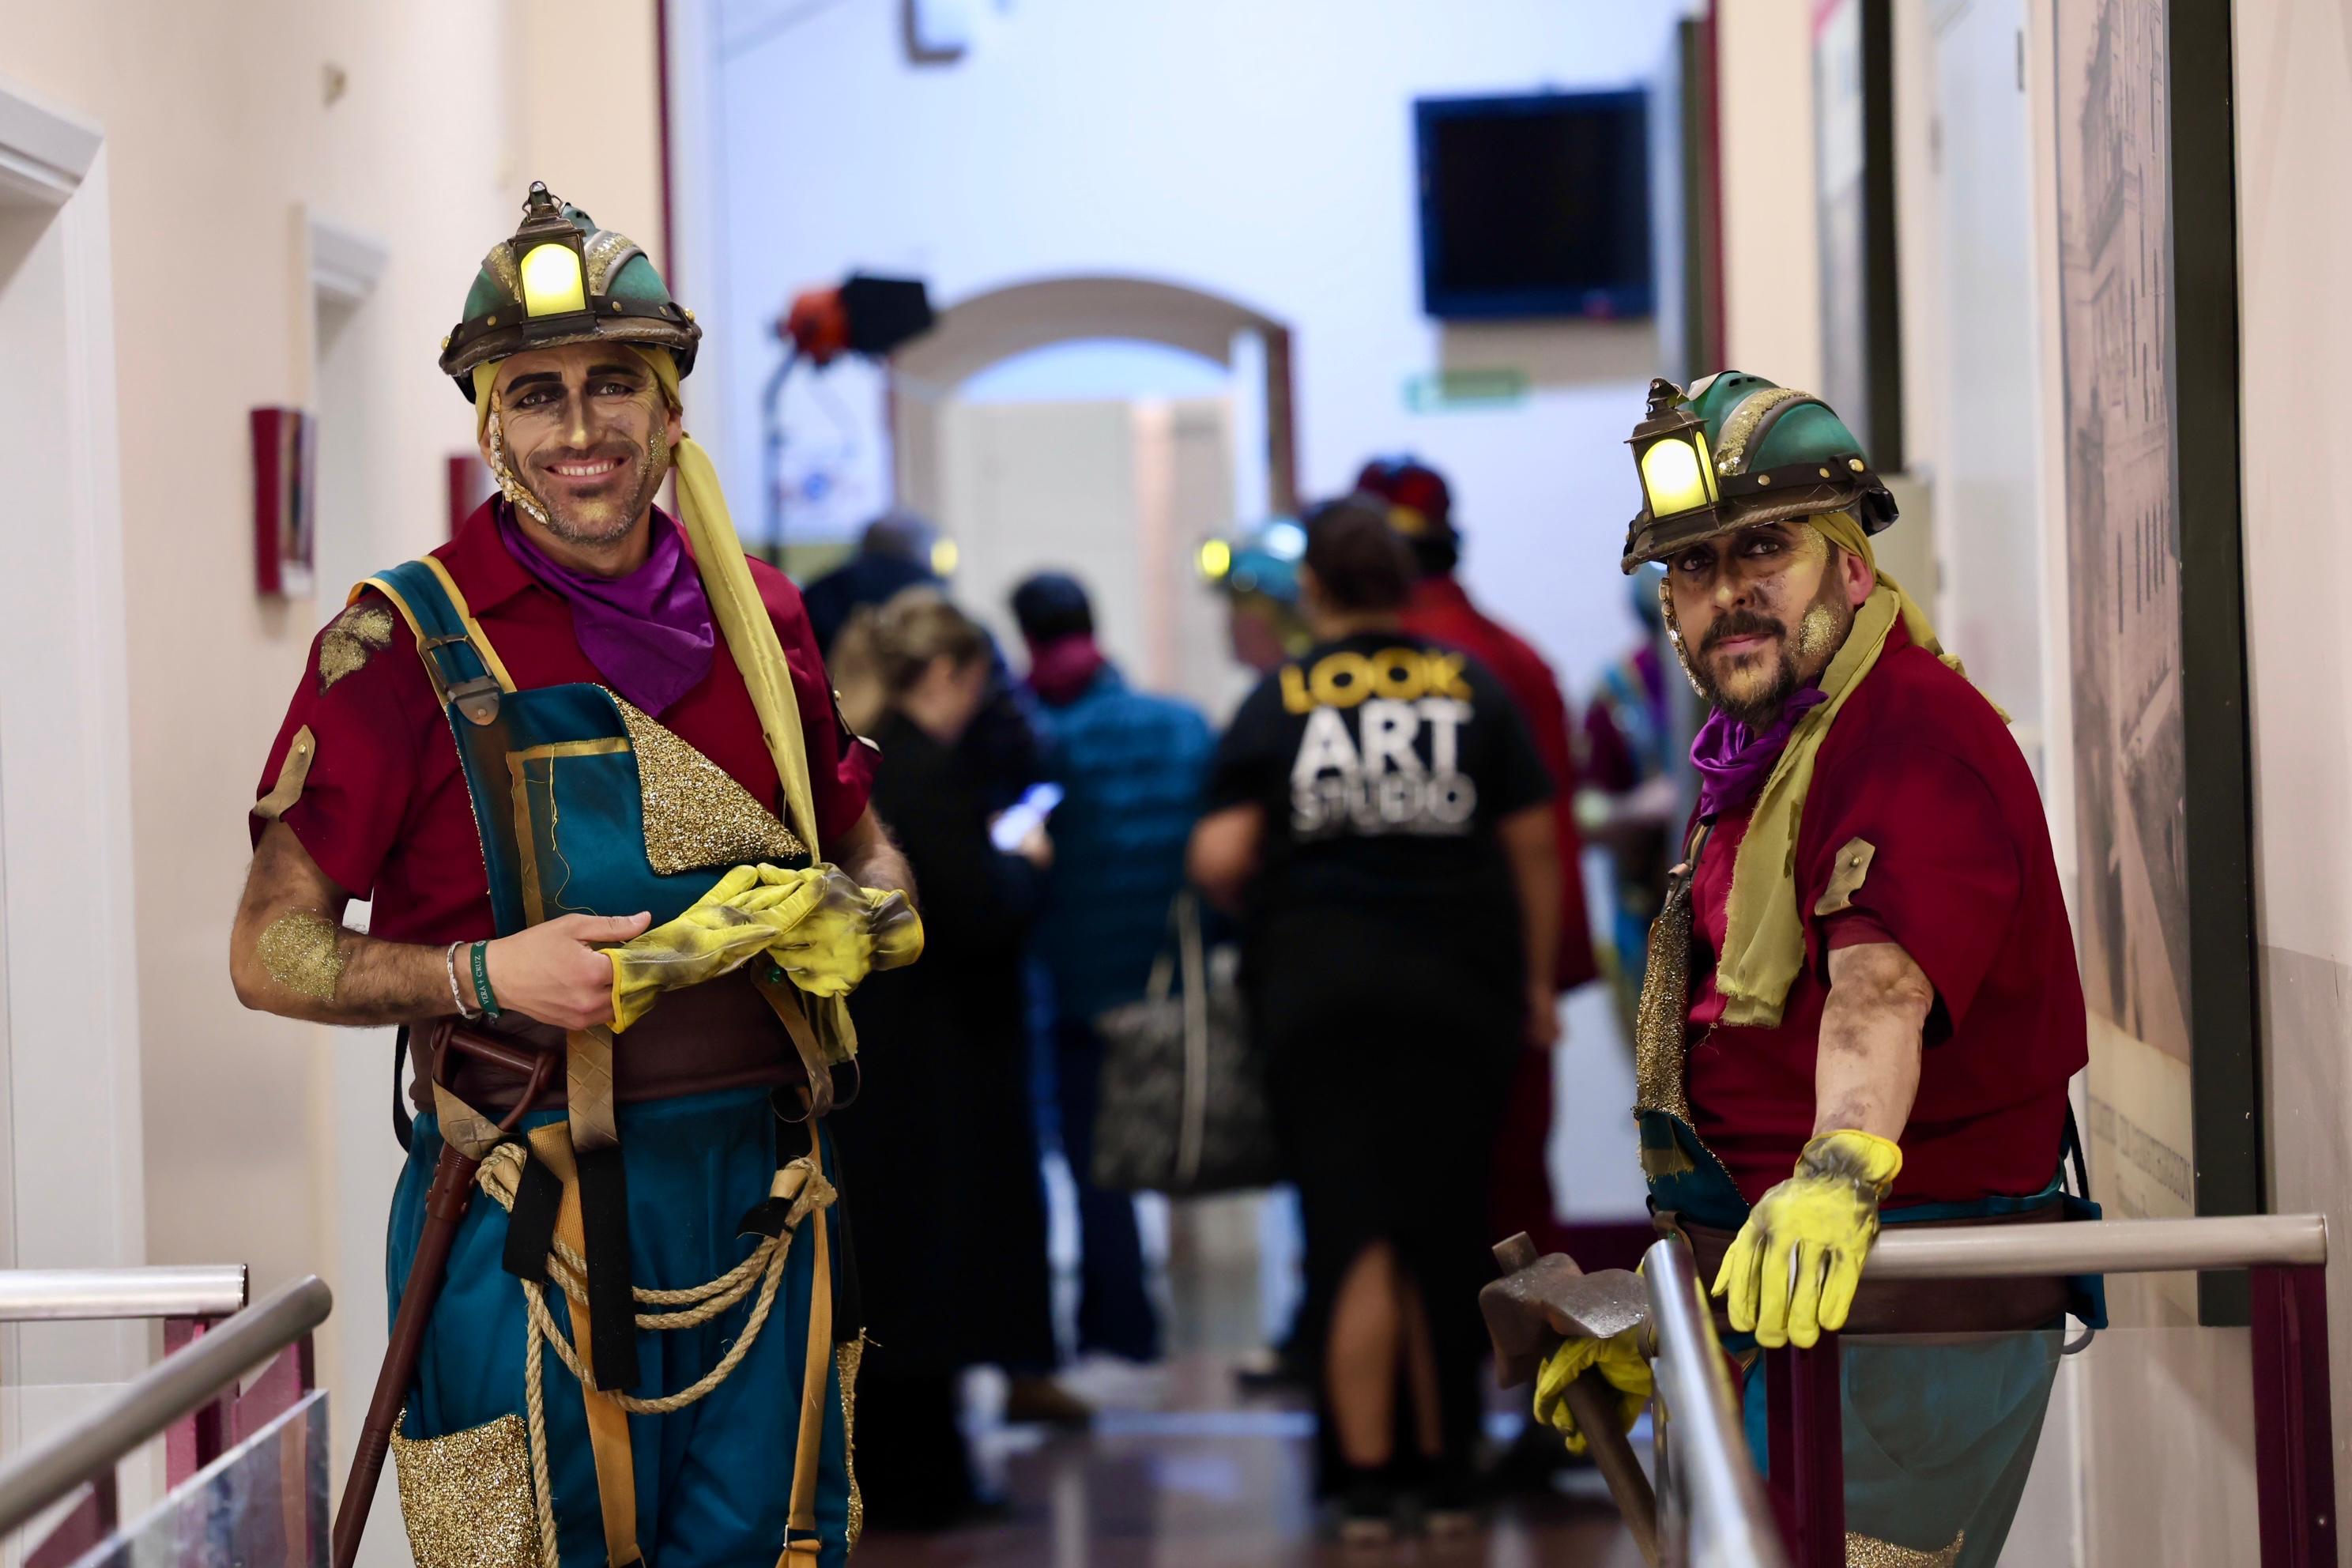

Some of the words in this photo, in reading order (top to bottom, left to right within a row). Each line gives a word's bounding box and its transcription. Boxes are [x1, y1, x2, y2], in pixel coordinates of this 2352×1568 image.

[1280, 647, 1473, 714] LOOK
[1291, 697, 1475, 792] ART
[474, 955, 483, 978] CRUZ
[480, 986, 489, 1004] VERA
